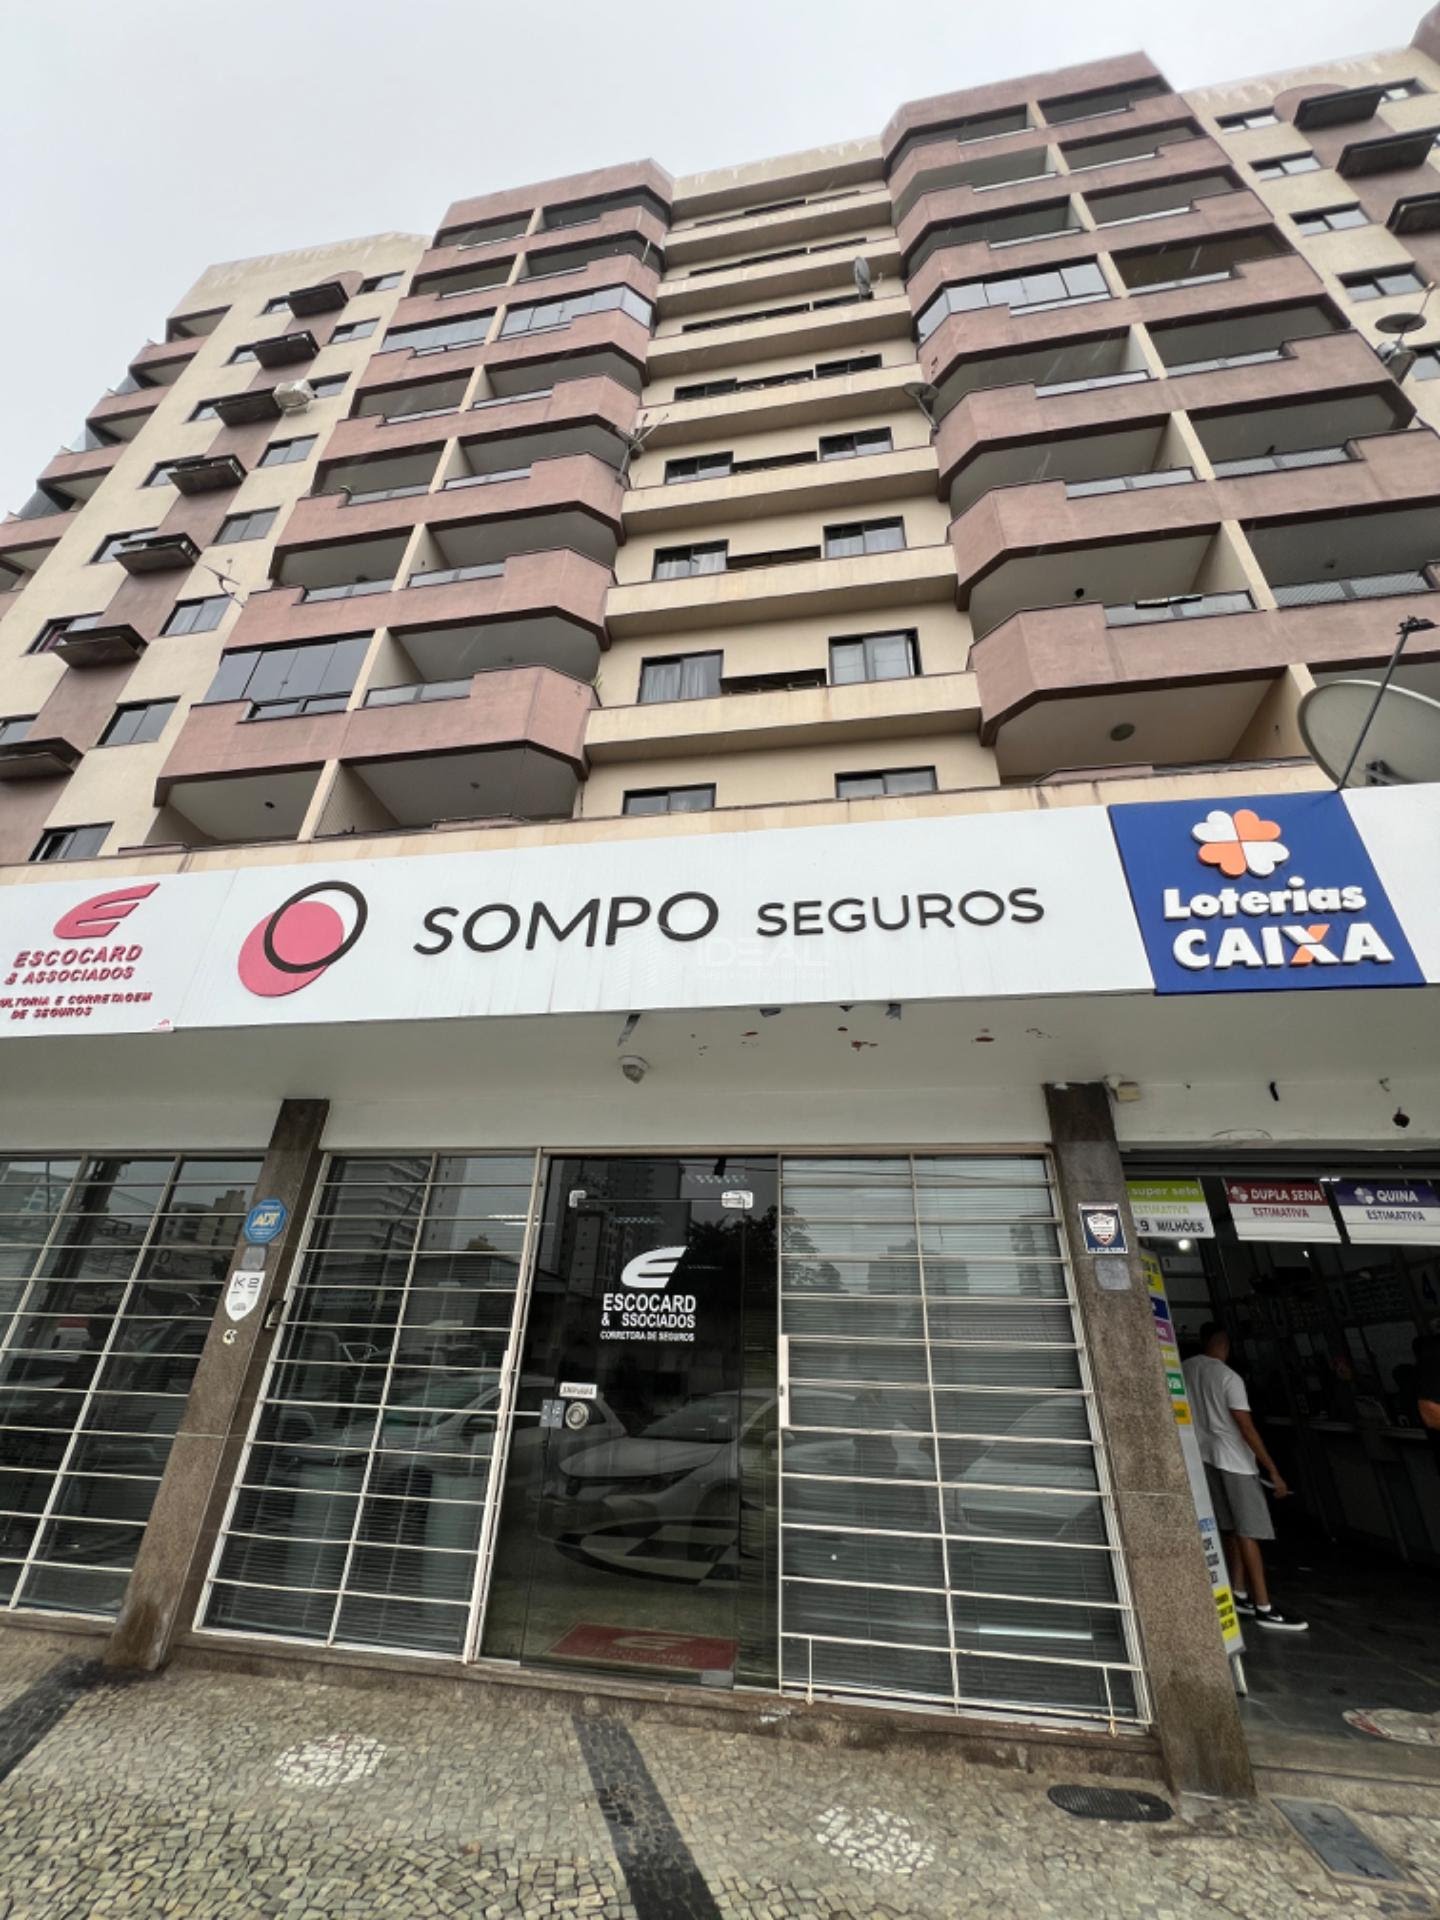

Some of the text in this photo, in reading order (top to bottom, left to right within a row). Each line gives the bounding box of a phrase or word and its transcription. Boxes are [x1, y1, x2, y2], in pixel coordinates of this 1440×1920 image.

[1163, 876, 1367, 920] Loterias
[413, 887, 1046, 955] SOMPO SEGUROS
[1172, 922, 1395, 970] CAIXA
[13, 944, 144, 968] ESCOCARD
[22, 966, 136, 984] ASSOCIADOS
[54, 995, 66, 1006] E
[67, 991, 154, 1005] CORRETAGEM
[11, 1006, 94, 1020] DE SEGUROS
[1250, 1189, 1323, 1202] DUPLA SENA
[1376, 1189, 1419, 1203] QUINA
[1133, 1203, 1189, 1215] ESTIMATIVA
[1252, 1206, 1310, 1219] ESTIMATIVA
[1365, 1208, 1426, 1222] ESTIMATIVA
[251, 1212, 281, 1228] ADT
[1155, 1218, 1205, 1233] MILHÕES
[602, 1292, 697, 1313] ESCOCARD
[601, 1311, 696, 1329] & SSOCIADOS
